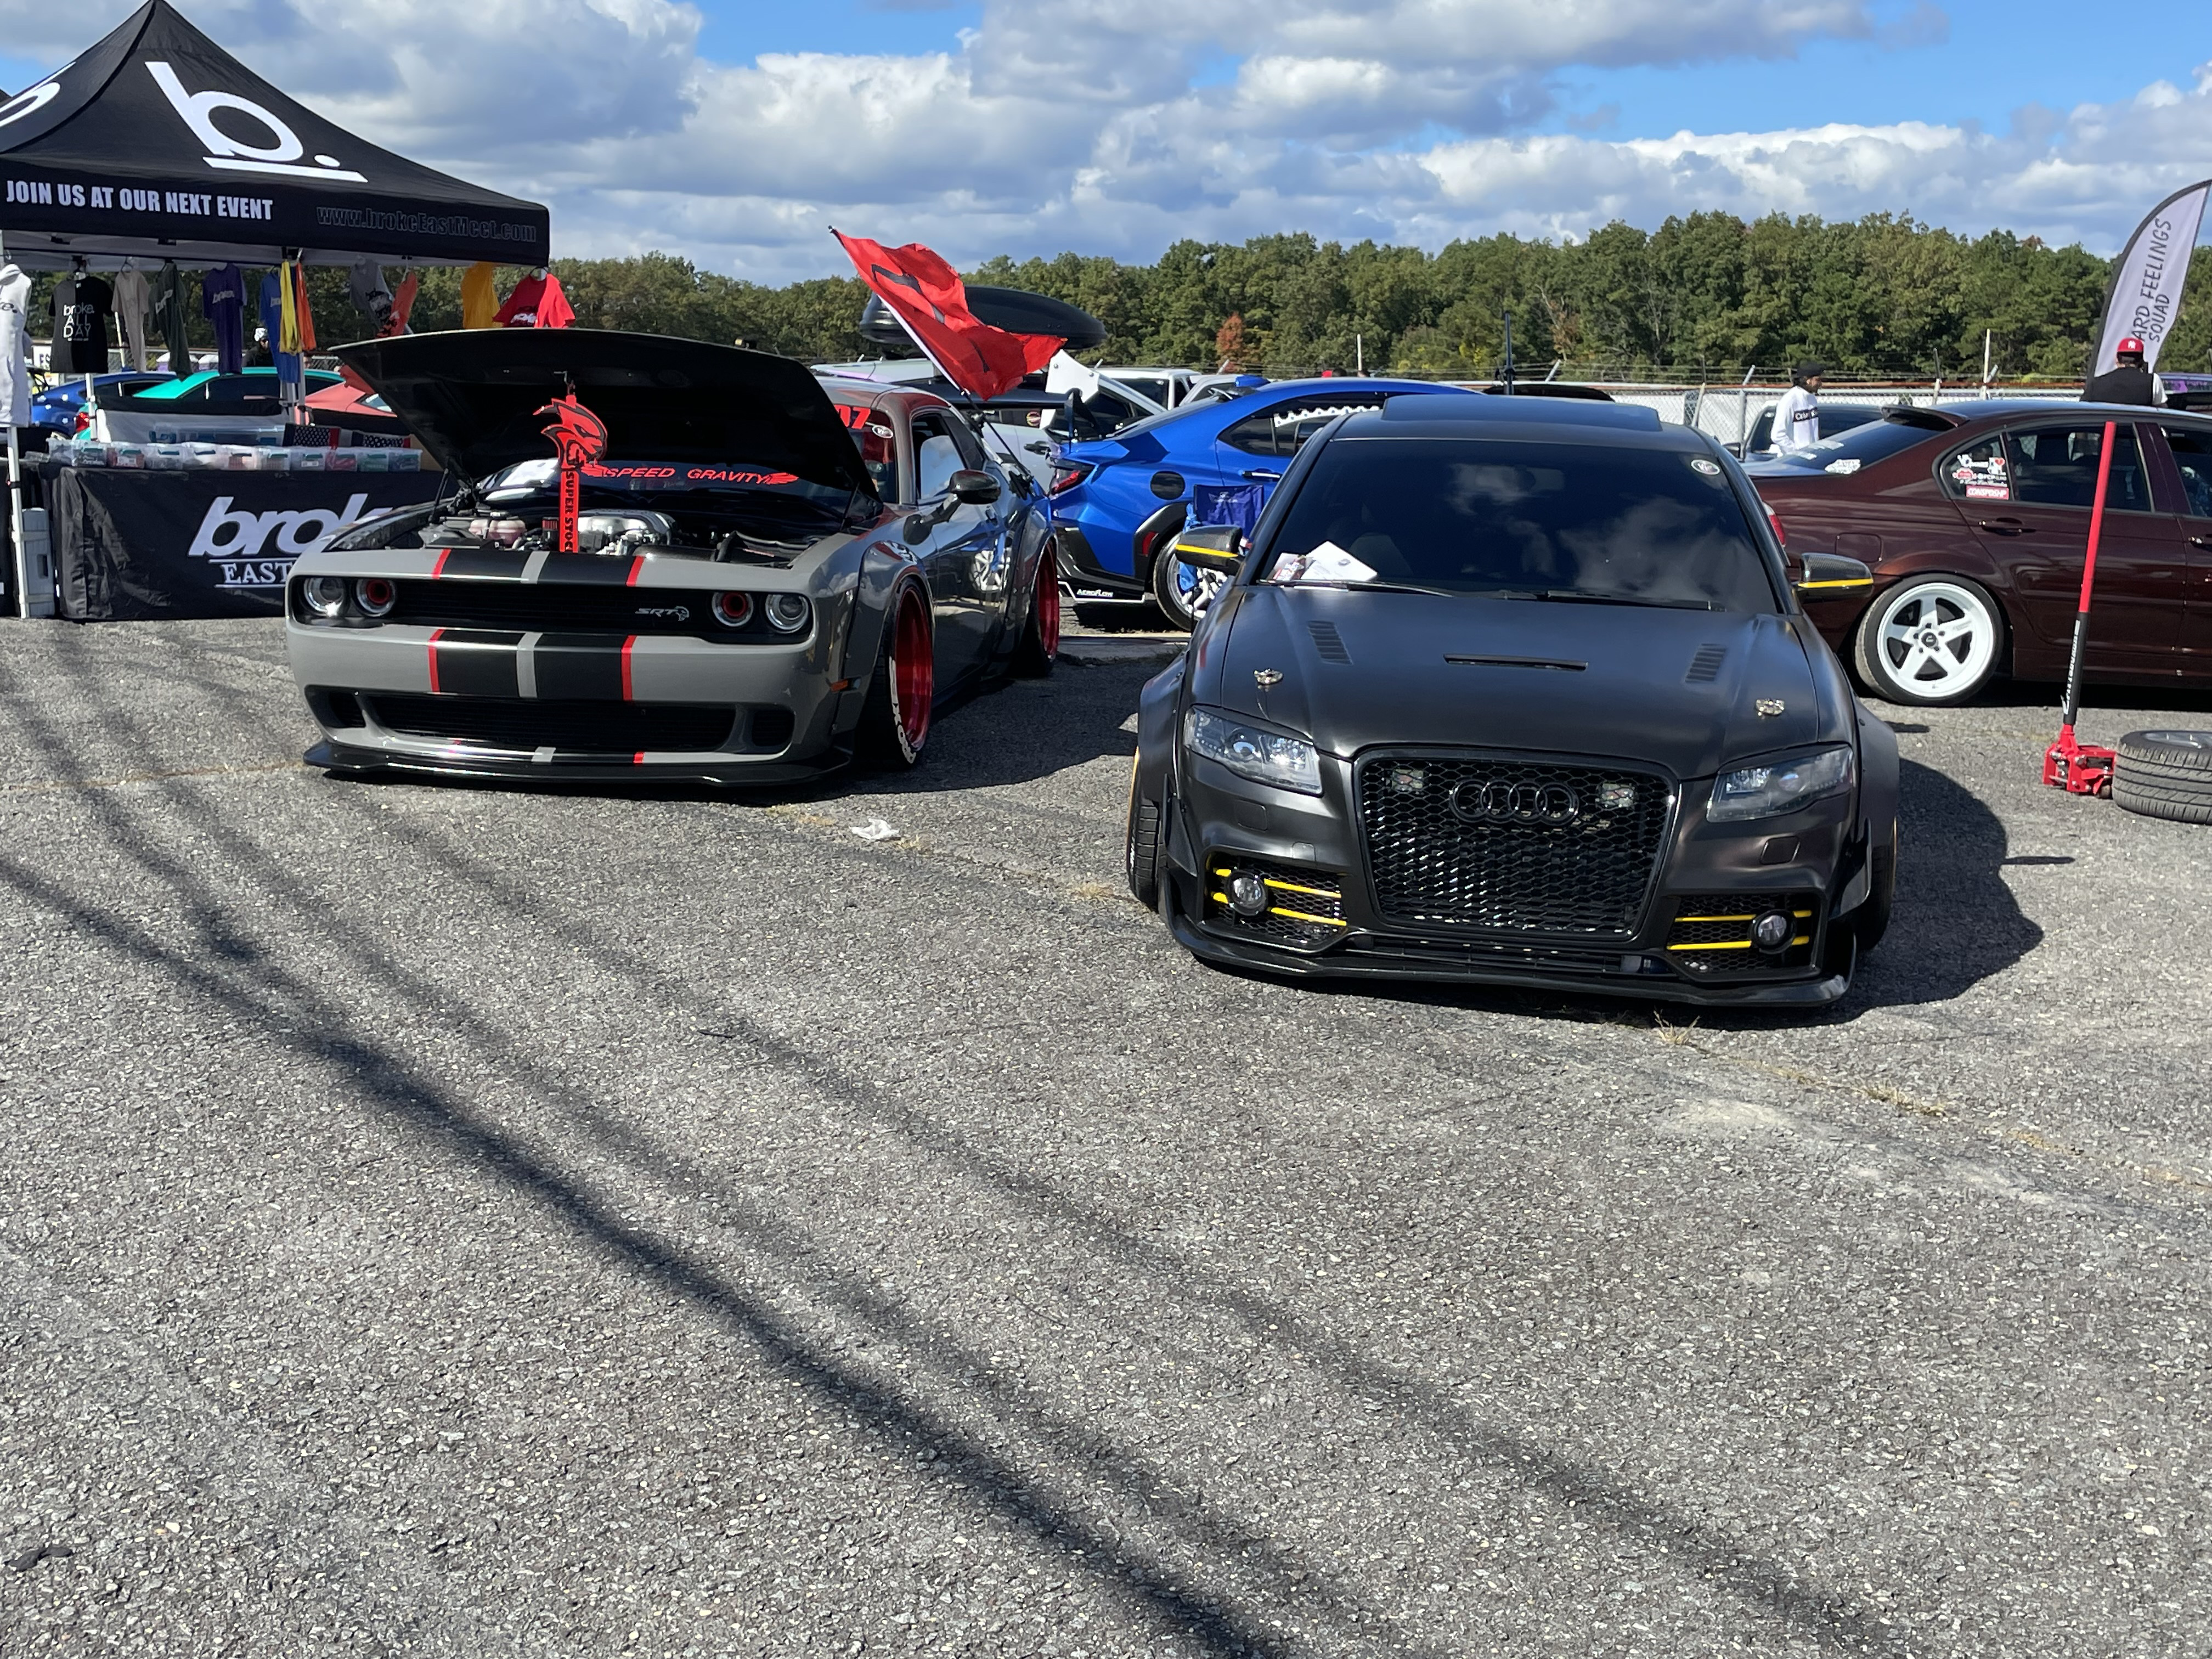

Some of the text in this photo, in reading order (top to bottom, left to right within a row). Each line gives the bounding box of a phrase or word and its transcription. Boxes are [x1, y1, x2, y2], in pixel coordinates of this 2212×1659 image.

[7, 180, 273, 220] JOIN US AT OUR NEXT EVENT
[2131, 218, 2171, 342] ARD FEELINGS
[63, 323, 91, 338] DAY
[65, 314, 91, 328] ALL
[2149, 294, 2169, 342] SQUAD
[607, 467, 766, 484] SPEED GRAVITY
[188, 493, 393, 556] brok
[565, 471, 574, 551] SUPER STOC
[221, 561, 293, 584] EAST
[635, 608, 679, 617] SRT
